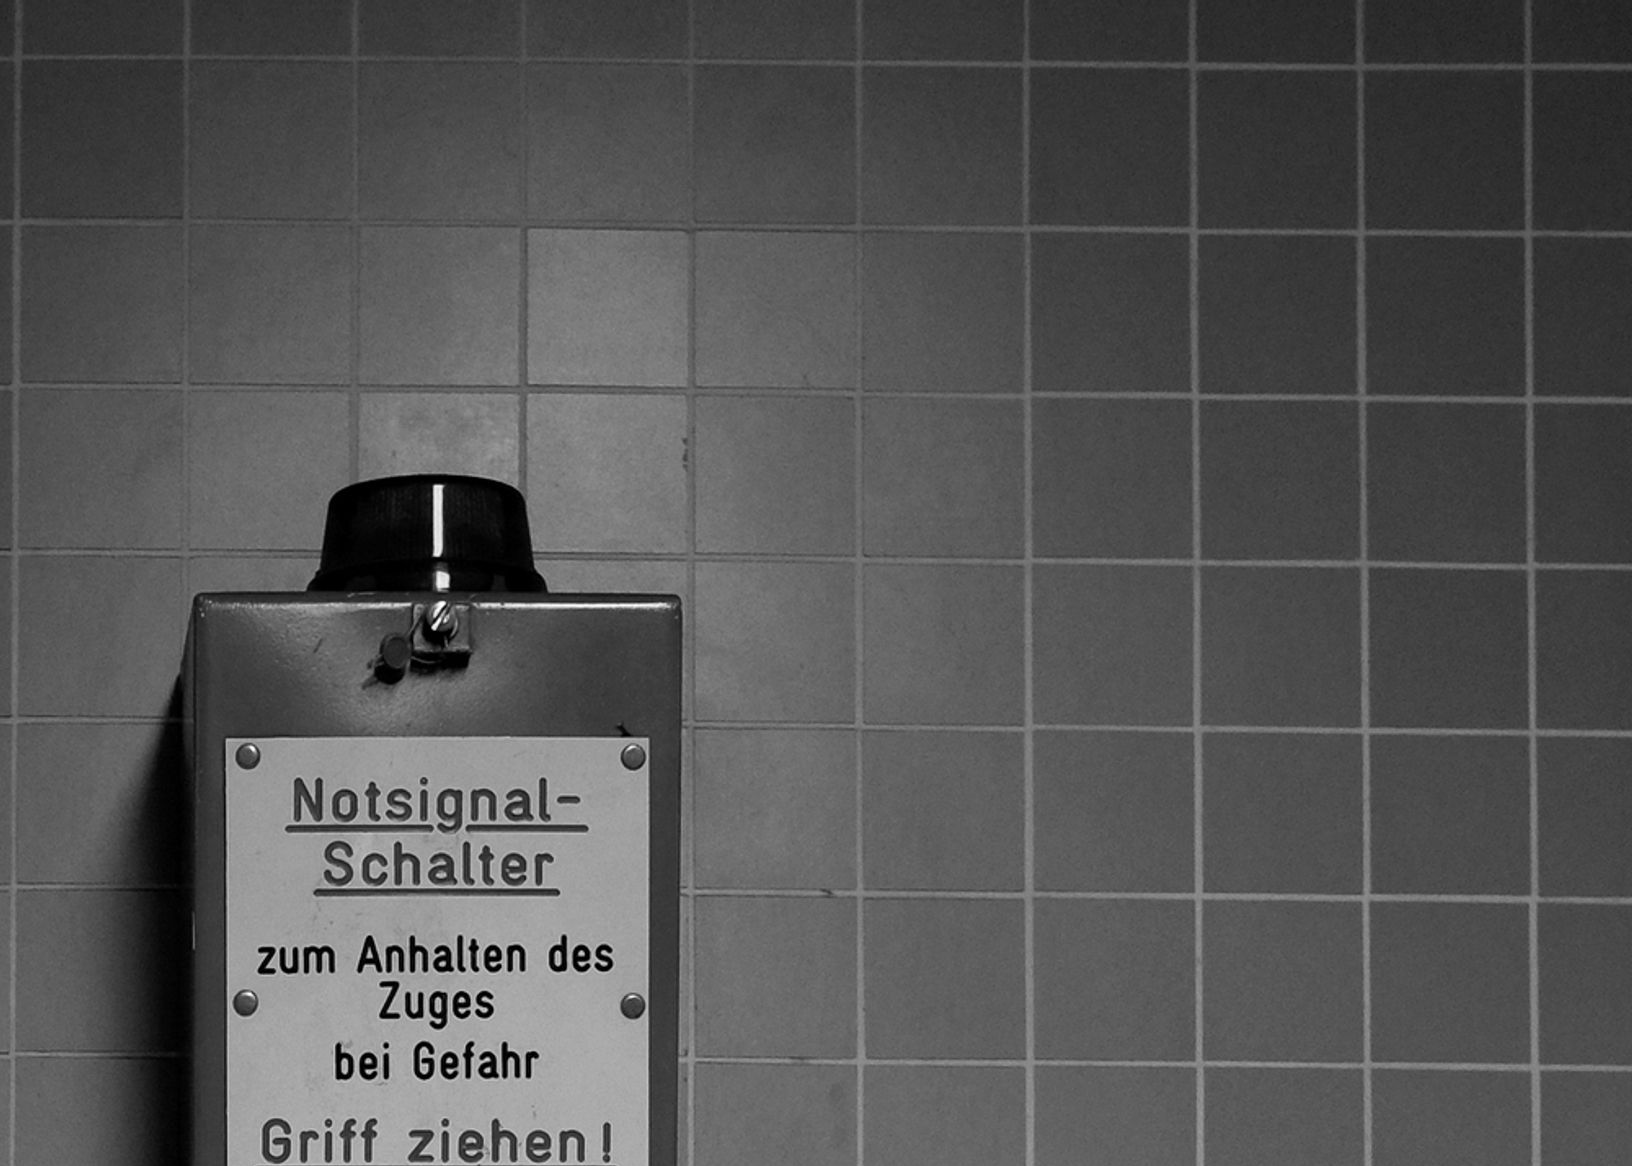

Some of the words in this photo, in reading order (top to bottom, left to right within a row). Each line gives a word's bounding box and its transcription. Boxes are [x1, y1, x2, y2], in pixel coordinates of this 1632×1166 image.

[292, 775, 582, 835] Notsignal-
[322, 839, 556, 888] Schalter
[255, 944, 337, 976] zum
[355, 933, 528, 975] Anhalten
[547, 932, 615, 974] des
[377, 979, 496, 1032] Zuges
[333, 1040, 391, 1082] bei
[412, 1039, 541, 1082] Gefahr
[260, 1116, 379, 1166] Griff
[406, 1116, 613, 1165] ziehen!
